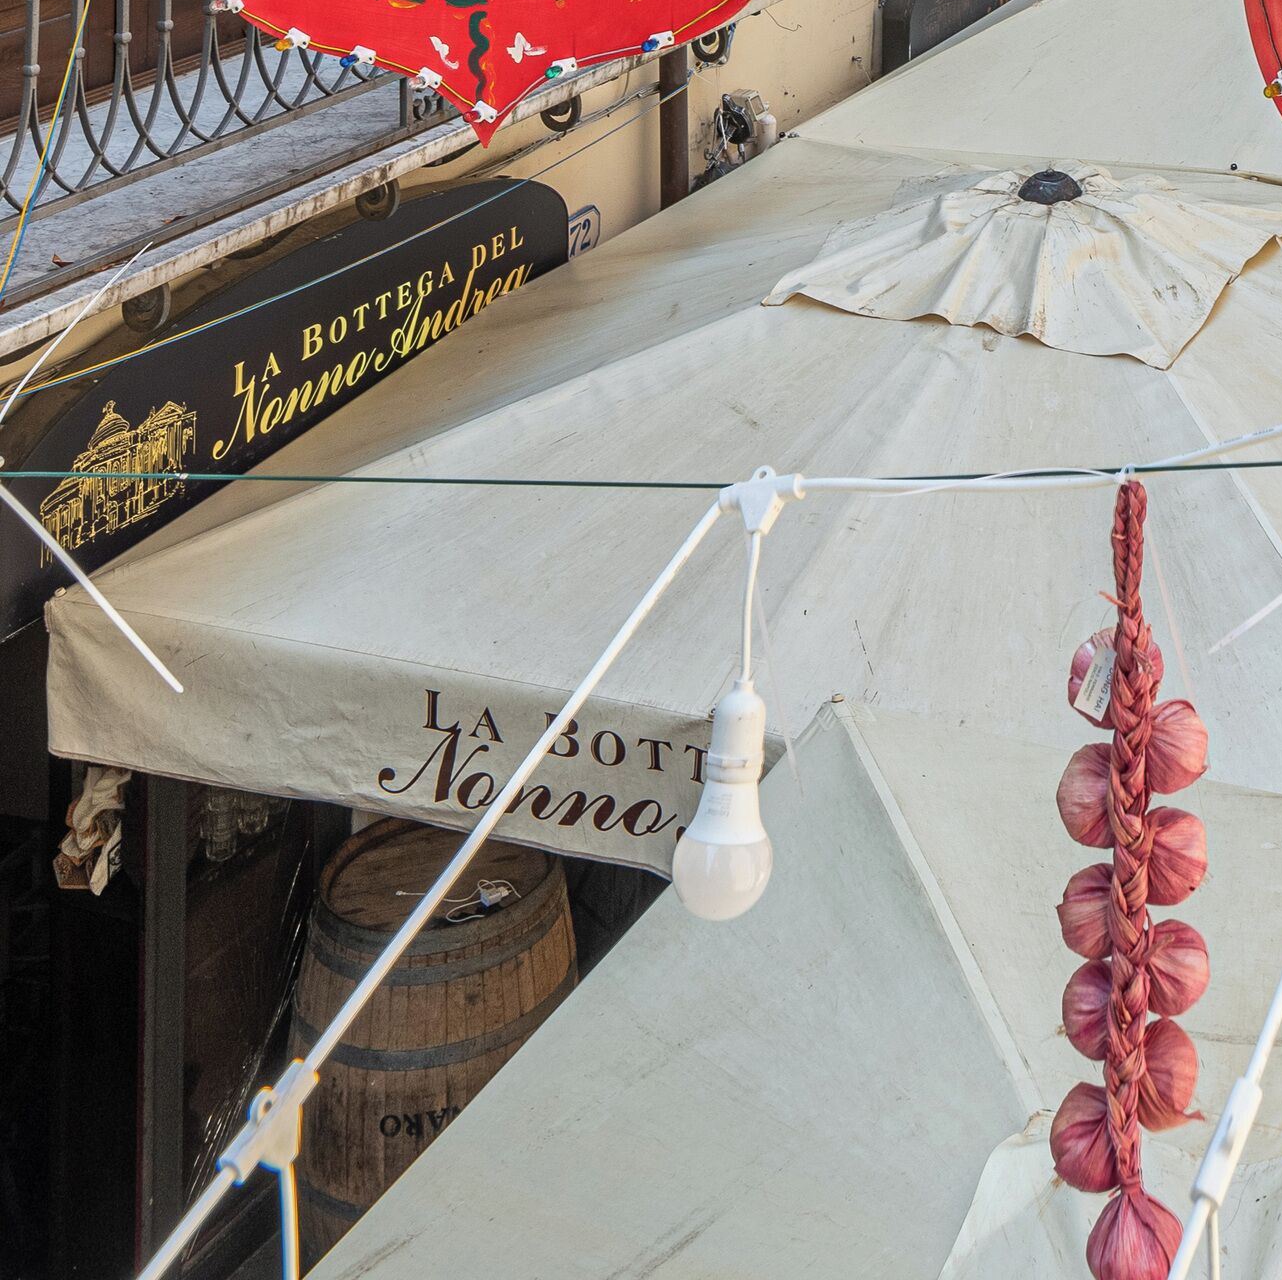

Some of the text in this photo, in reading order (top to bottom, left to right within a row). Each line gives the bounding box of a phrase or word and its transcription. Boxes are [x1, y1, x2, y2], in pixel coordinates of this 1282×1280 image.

[211, 262, 534, 461] Nonno Andrea
[232, 225, 525, 398] LA BOTTEGA DEL
[377, 727, 678, 837] Nonno
[422, 688, 505, 744] LA
